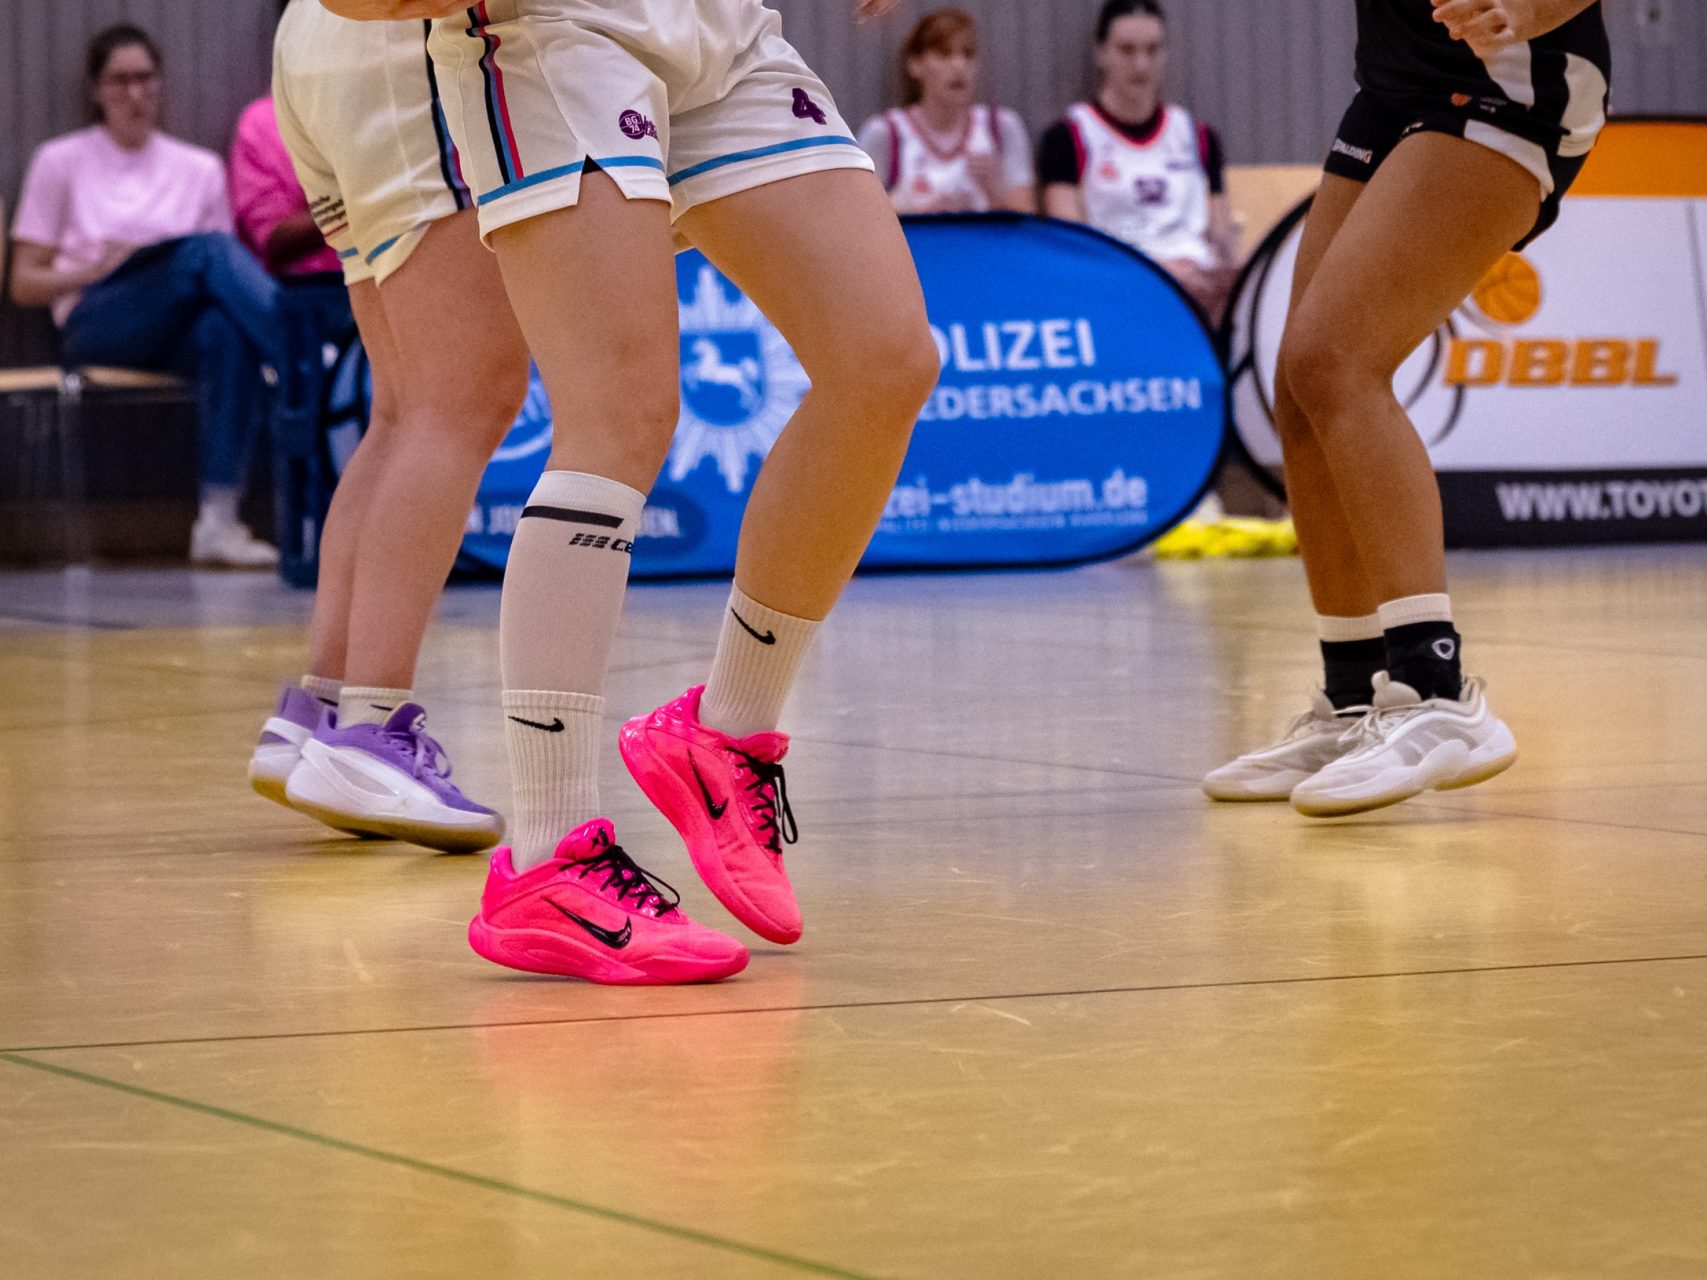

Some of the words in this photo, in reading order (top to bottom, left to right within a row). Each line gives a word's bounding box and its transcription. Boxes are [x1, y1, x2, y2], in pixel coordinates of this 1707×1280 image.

[625, 115, 639, 126] BG
[792, 87, 827, 125] 4
[1332, 138, 1373, 164] SPALDING
[930, 319, 1096, 371] LIZEI
[1444, 338, 1679, 388] DBBL
